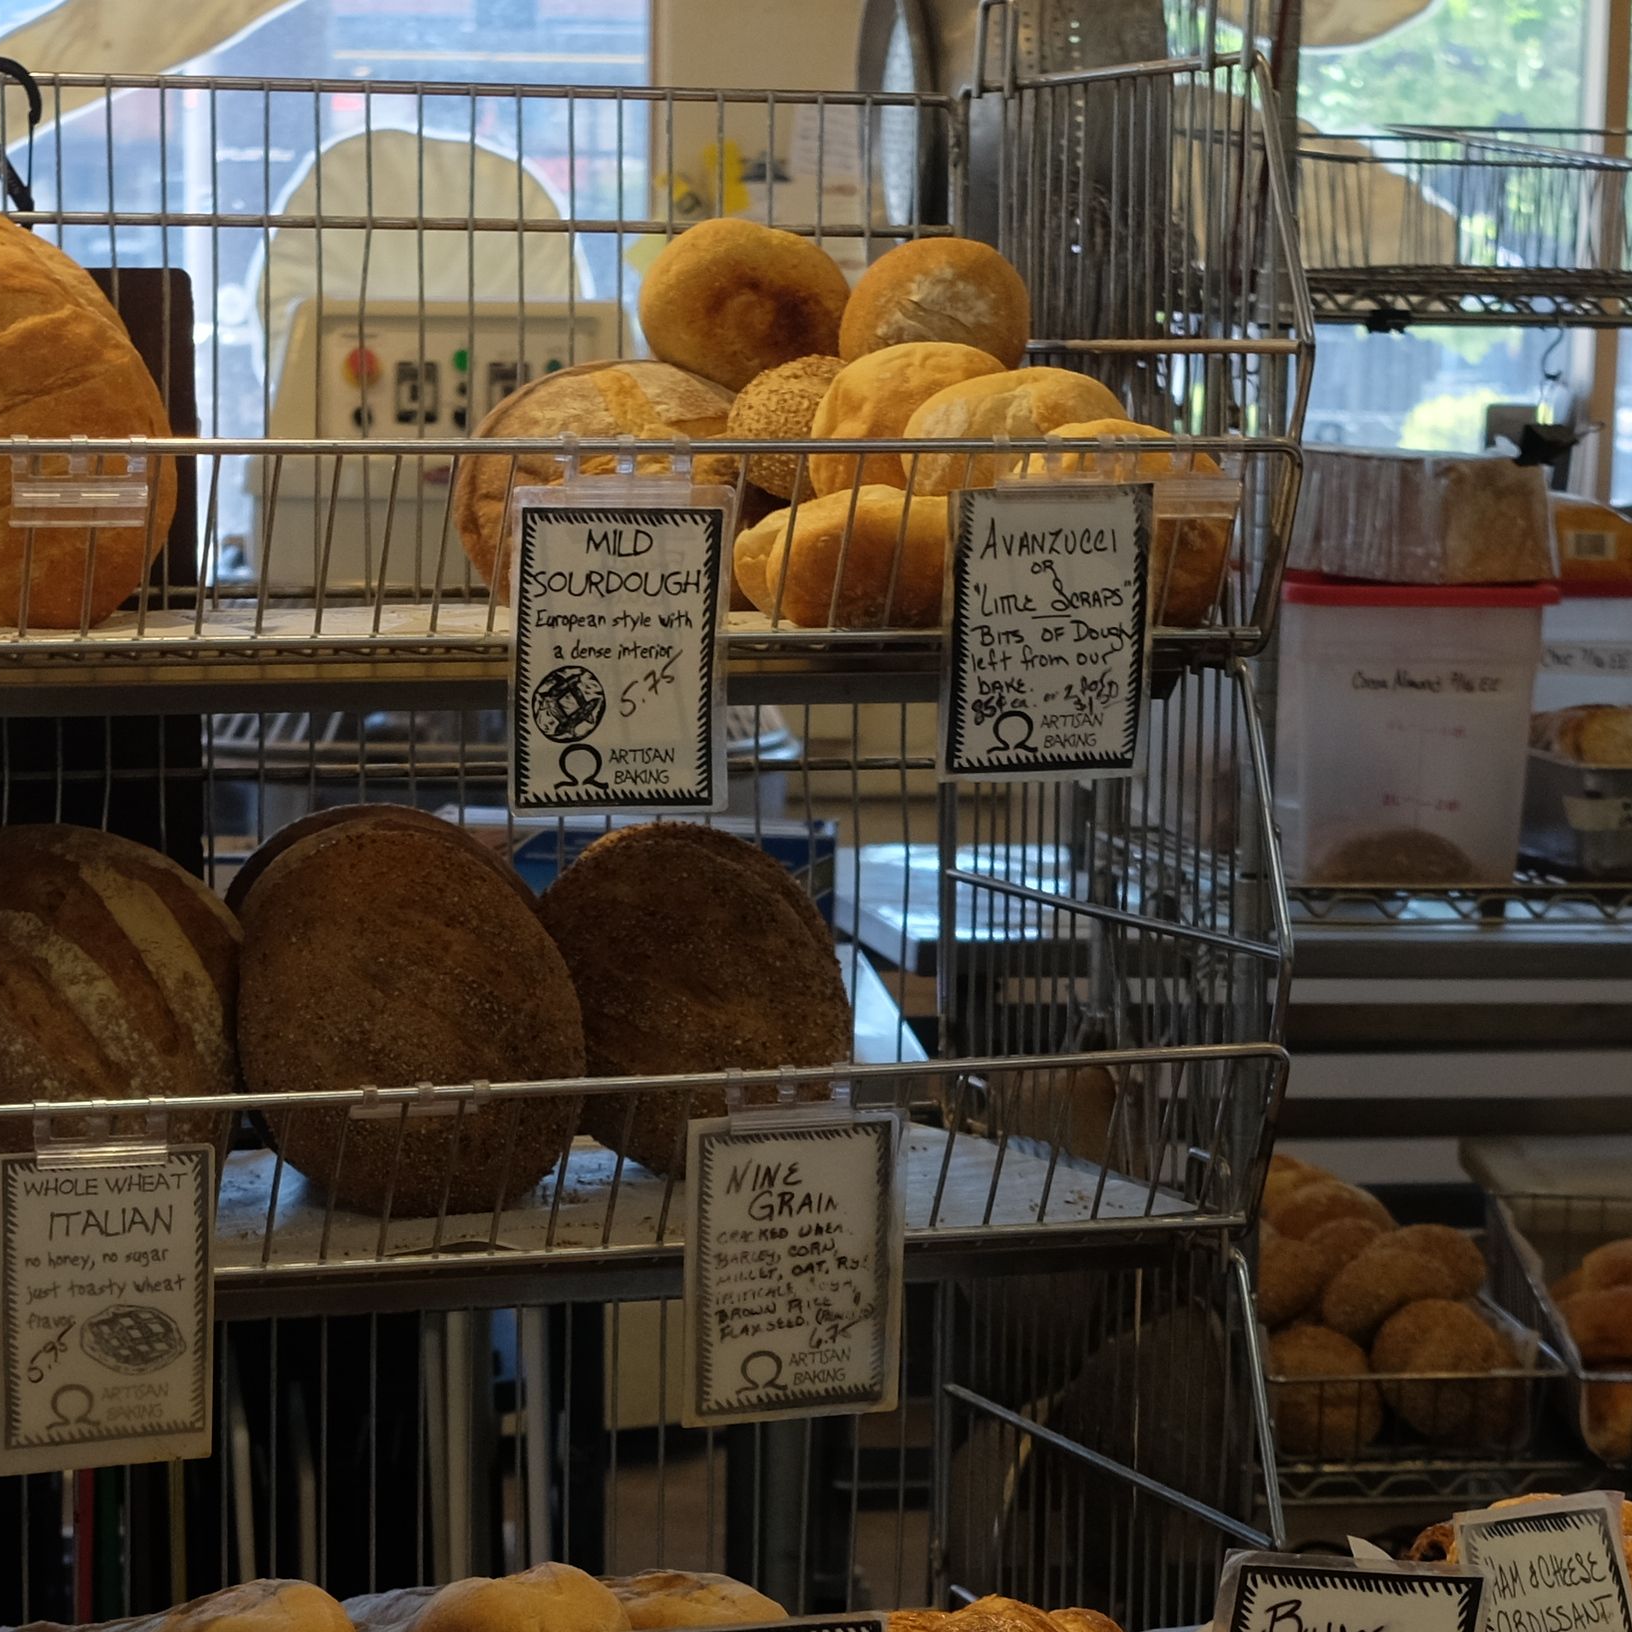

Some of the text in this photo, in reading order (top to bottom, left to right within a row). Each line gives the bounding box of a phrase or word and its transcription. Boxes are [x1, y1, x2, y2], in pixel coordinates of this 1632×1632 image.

[586, 528, 653, 557] MILD
[980, 517, 1117, 559] AVANZUCCI
[533, 570, 702, 598] SOURDOUGH
[535, 610, 692, 631] European style with
[1041, 627, 1064, 642] OF
[554, 640, 672, 659] a dense interior
[971, 645, 1114, 671] left from our
[1041, 713, 1104, 728] ARTISAN
[1044, 734, 1097, 749] BAKING
[609, 748, 675, 764] ARTISAN
[614, 769, 669, 784] BAKING
[24, 1173, 188, 1197] WHOLE WHEAT
[49, 1205, 173, 1240] ITALIAN
[25, 1249, 168, 1271] no honey, no sugar
[26, 1275, 185, 1305] just toasty wheat
[789, 1349, 851, 1366] ARTISAN
[794, 1369, 846, 1385] BAKING
[1539, 1553, 1606, 1589] CHEESE
